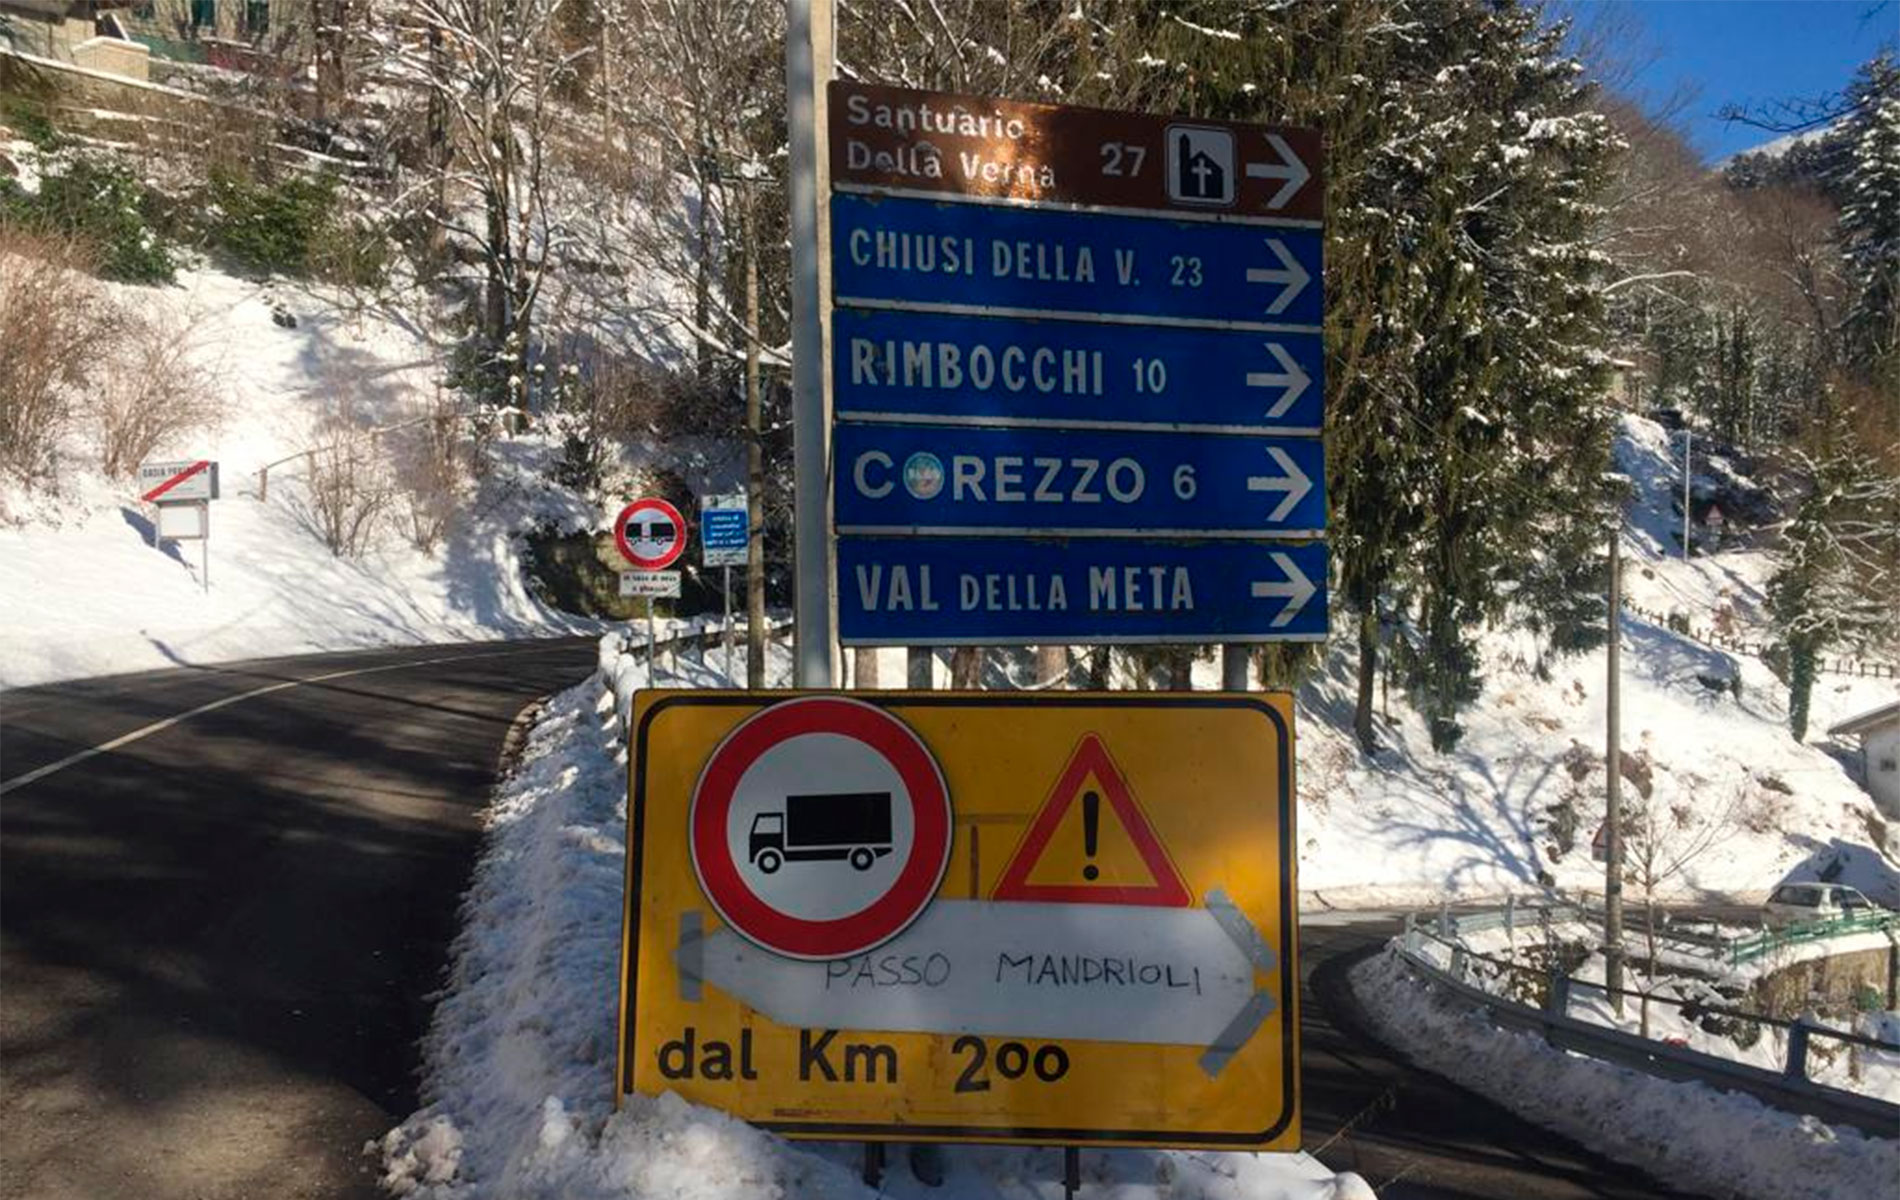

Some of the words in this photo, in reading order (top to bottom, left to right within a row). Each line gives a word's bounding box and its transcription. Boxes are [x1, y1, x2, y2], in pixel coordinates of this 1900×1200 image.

[846, 95, 1026, 142] Santuario
[846, 140, 943, 180] Della
[959, 151, 1056, 191] Verna
[1100, 142, 1147, 178] 27
[849, 227, 975, 276] CHIUSI
[992, 240, 1096, 283] DELLA
[1115, 250, 1141, 286] V.
[1170, 256, 1203, 288] 23
[850, 337, 1104, 396] RIMBOCCHI
[1133, 358, 1167, 394] 10
[853, 450, 1146, 504] CREZZO
[1172, 465, 1197, 500] 6
[856, 564, 940, 611] VAL
[959, 573, 1068, 610] DELLA
[1089, 565, 1195, 610] META
[825, 952, 952, 990] PASSO
[997, 950, 1203, 996] MANDRIOLI
[658, 1028, 759, 1081] dal
[799, 1029, 899, 1083] Km
